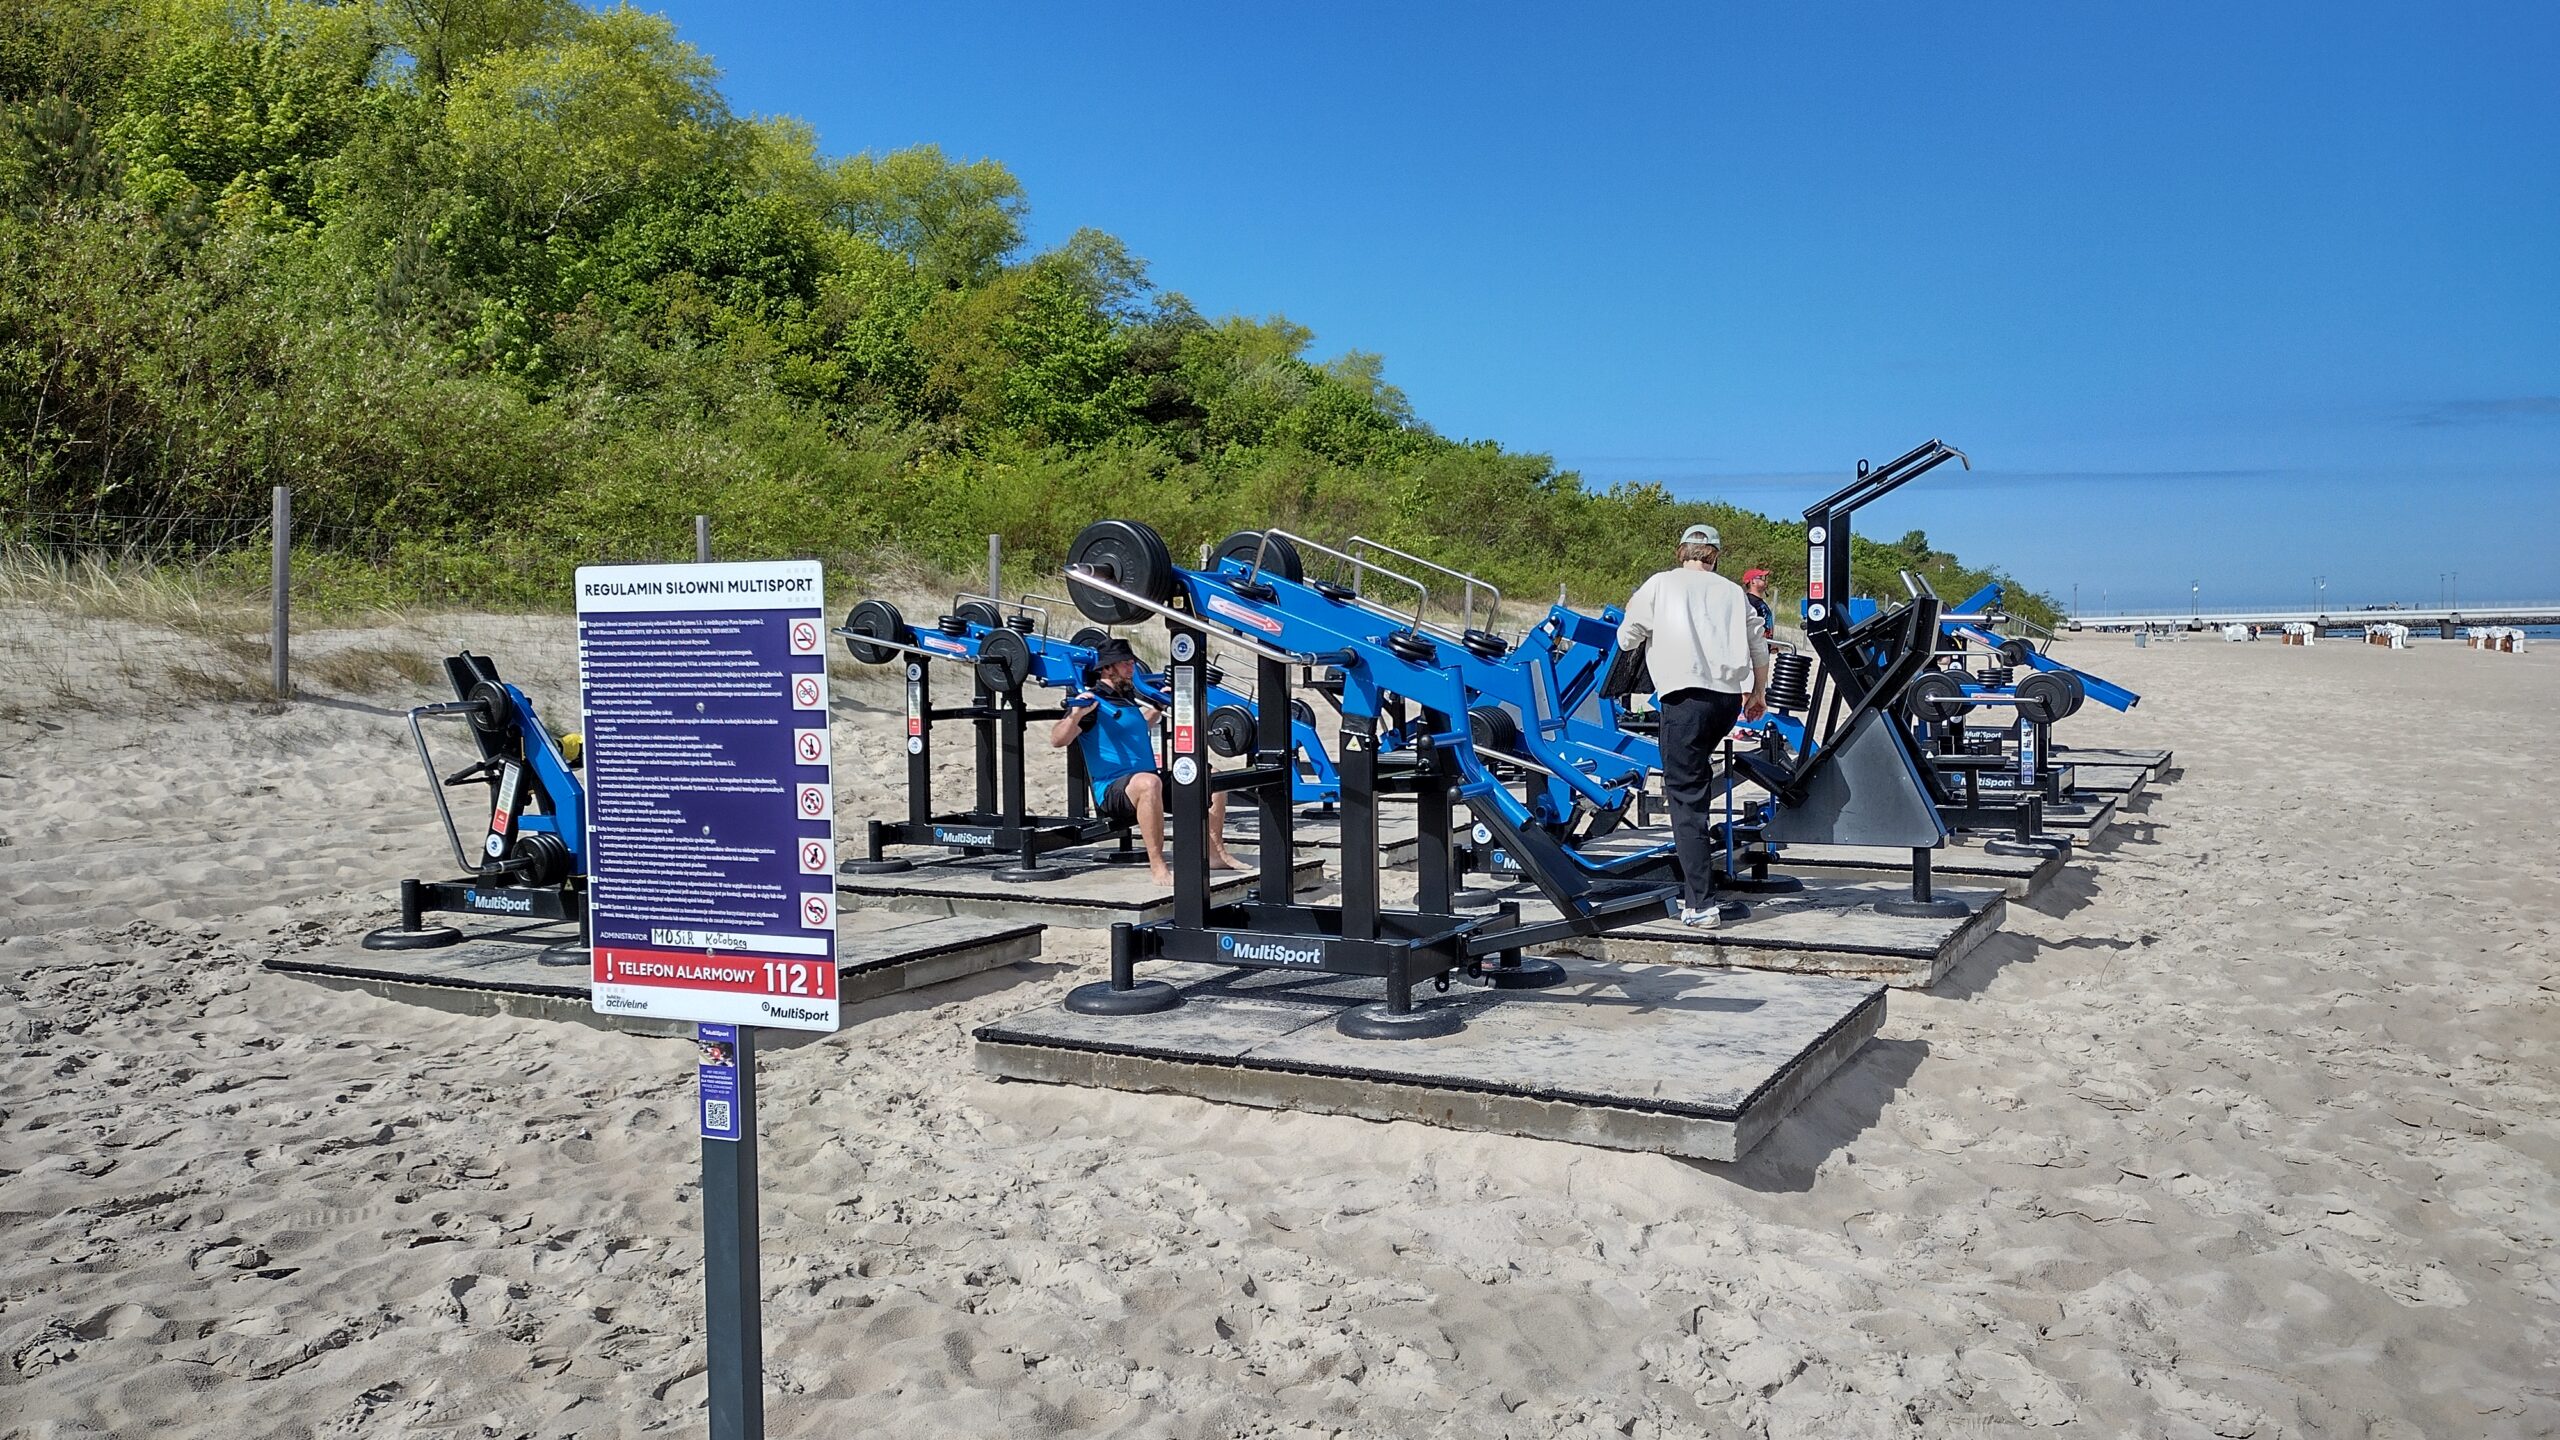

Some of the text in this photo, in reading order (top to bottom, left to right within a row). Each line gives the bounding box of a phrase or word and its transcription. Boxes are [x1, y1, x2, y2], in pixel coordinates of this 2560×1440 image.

[585, 578, 813, 597] REGULAMIN SIŁOWNI MULTISPORT
[943, 833, 992, 845] MultiSport
[475, 895, 531, 913] MultiSport
[600, 932, 648, 940] ADMINISTRATOR
[1233, 943, 1320, 964] MultiSport
[618, 961, 674, 978] TELEFON
[676, 965, 756, 983] ALARMOWY
[763, 962, 808, 995] 112
[606, 999, 648, 1010] activeline
[770, 1007, 829, 1022] MultiSport
